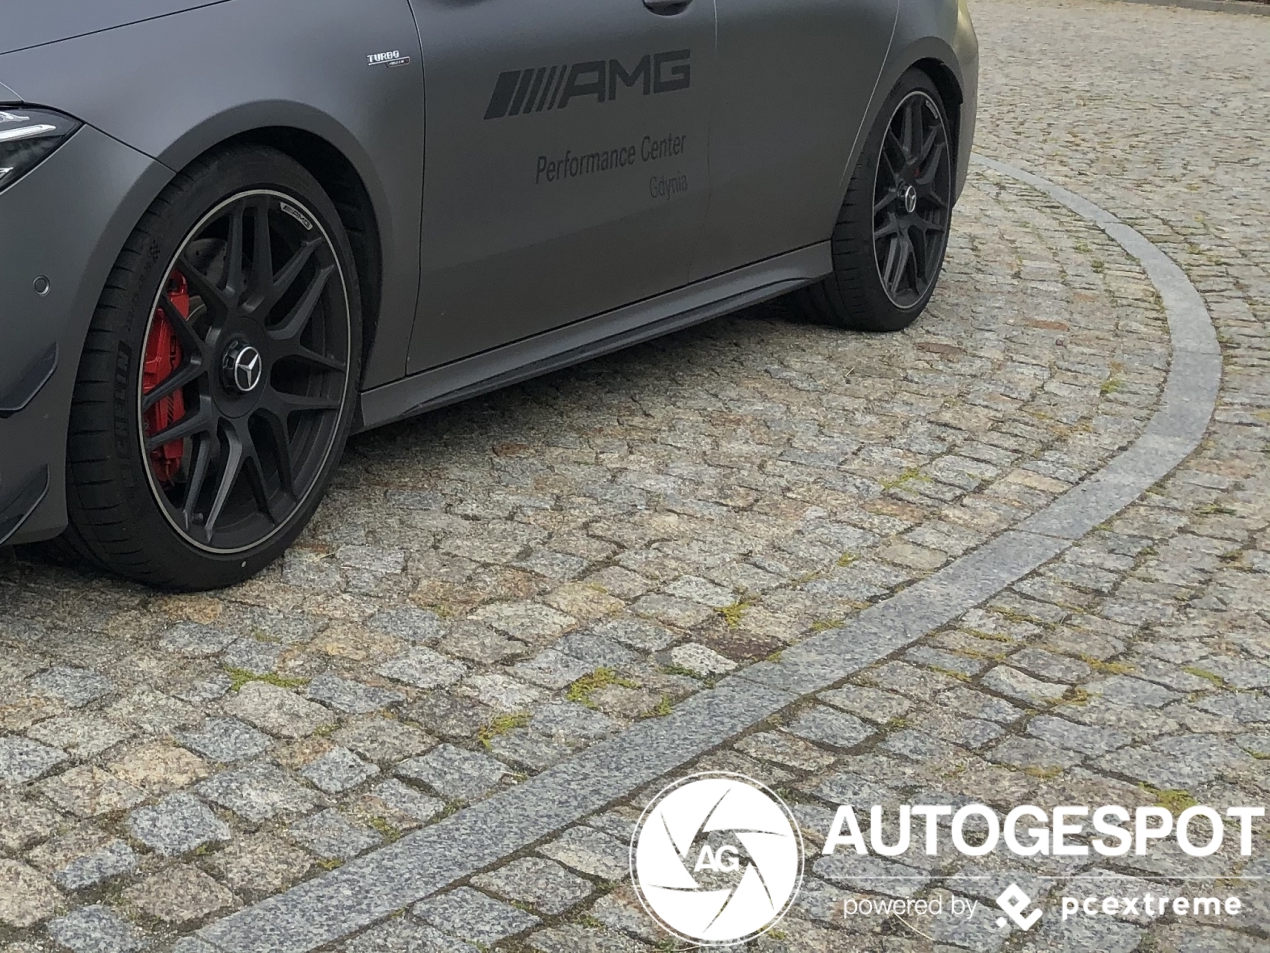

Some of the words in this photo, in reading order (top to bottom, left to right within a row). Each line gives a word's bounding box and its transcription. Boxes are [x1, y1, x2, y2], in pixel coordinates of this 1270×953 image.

[367, 50, 399, 62] TURBO
[557, 49, 690, 109] AMG
[536, 145, 636, 184] Performance
[641, 133, 687, 162] Center
[650, 171, 689, 200] Gdynia
